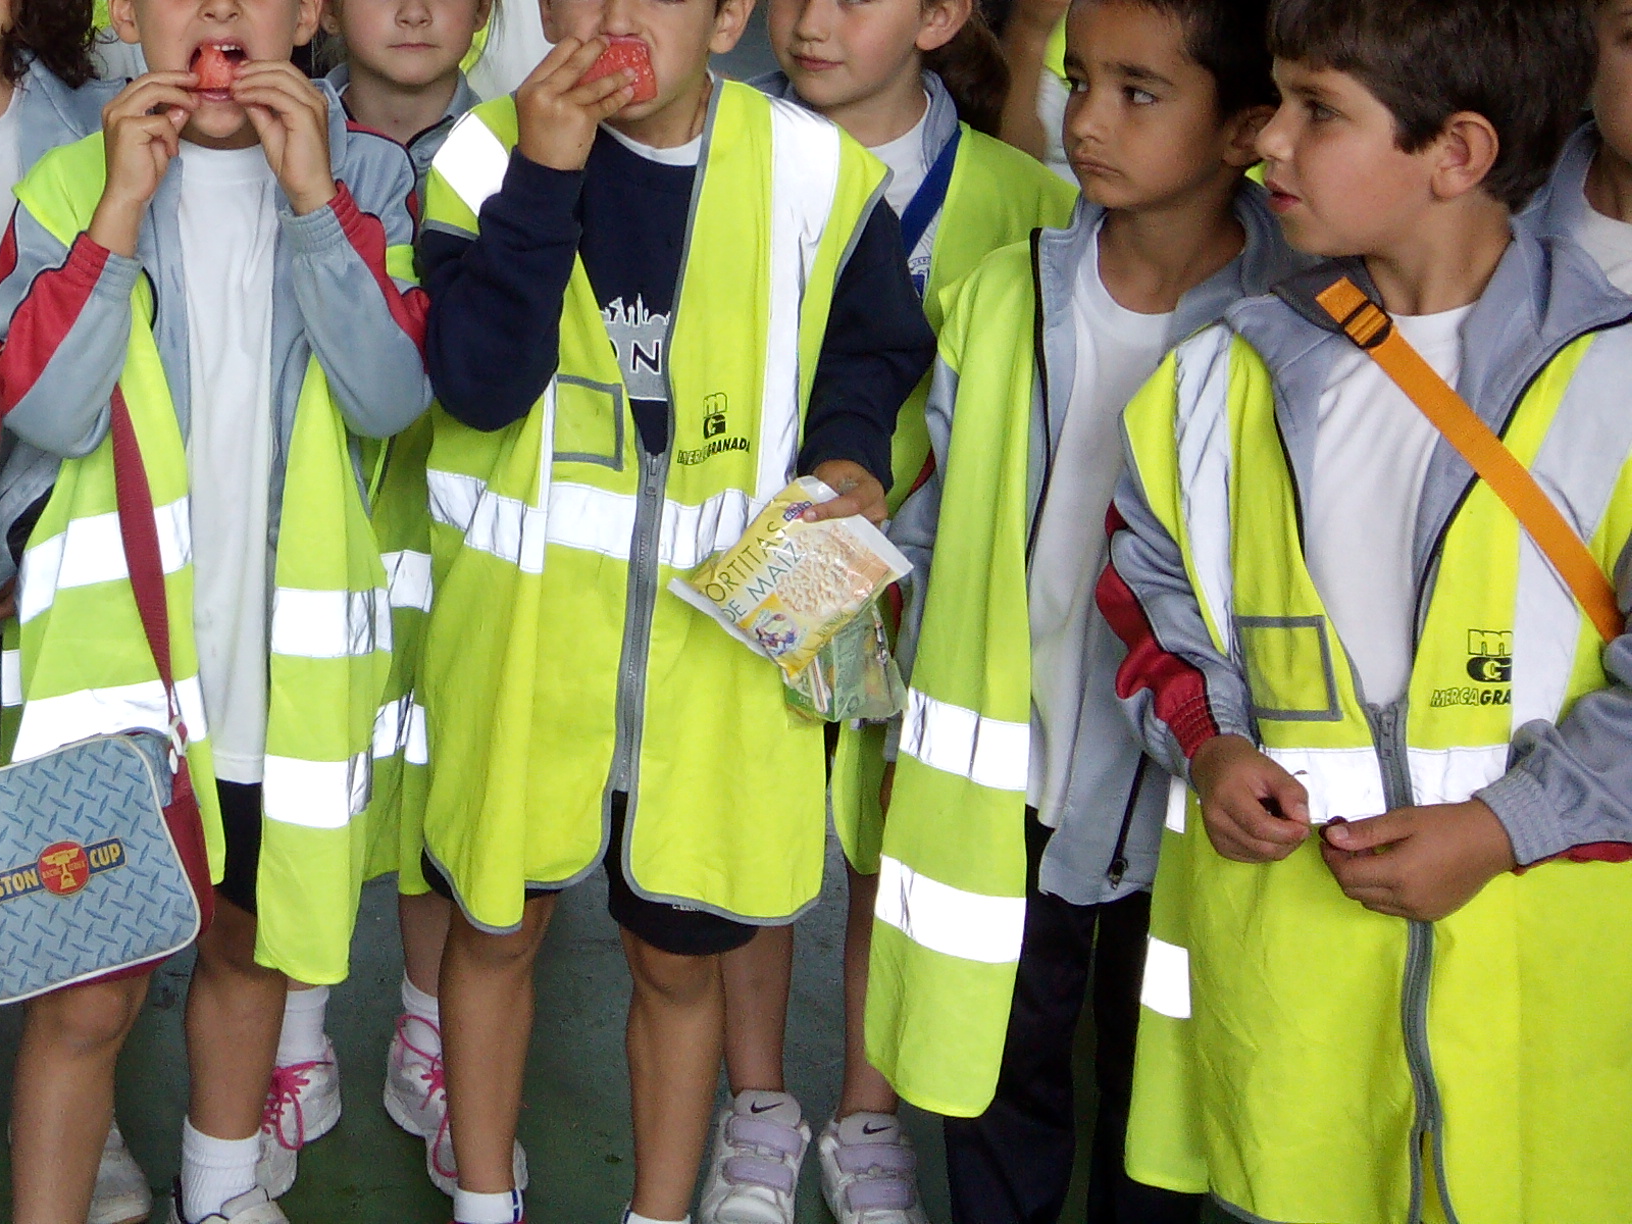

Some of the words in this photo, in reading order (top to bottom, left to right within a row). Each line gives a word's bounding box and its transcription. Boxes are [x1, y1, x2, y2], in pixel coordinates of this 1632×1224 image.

[704, 520, 787, 602] ORTITAS
[746, 541, 802, 602] MAÍZ
[89, 843, 121, 868] CUP
